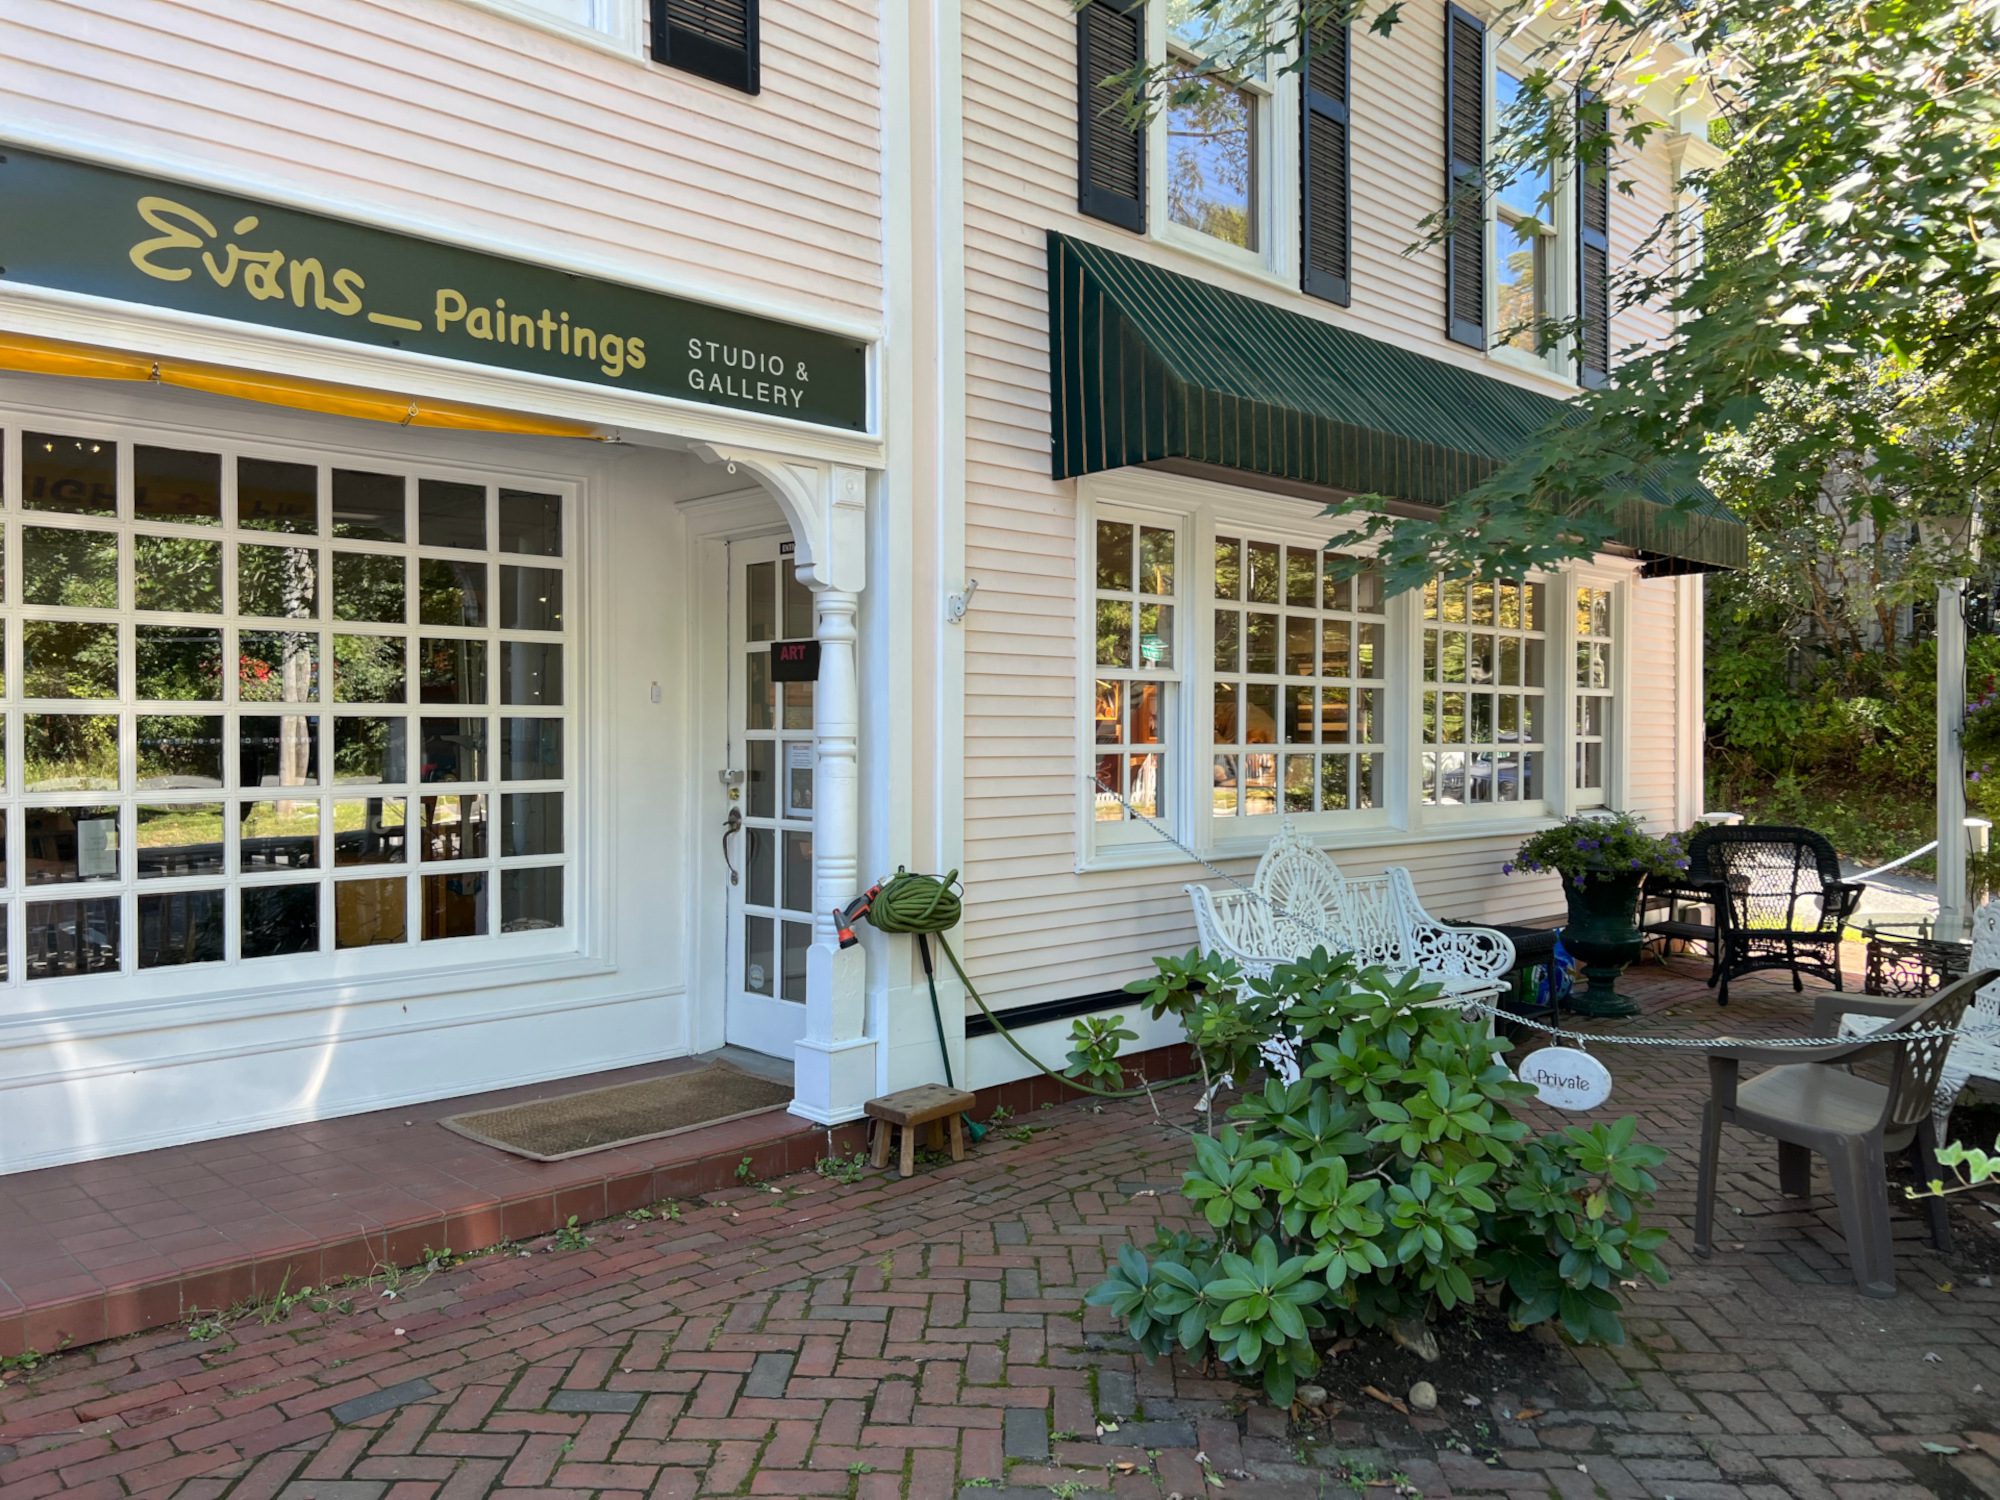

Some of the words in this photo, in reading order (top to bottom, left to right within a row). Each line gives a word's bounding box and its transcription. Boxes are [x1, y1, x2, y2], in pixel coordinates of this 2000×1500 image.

[434, 288, 647, 378] Paintings
[687, 337, 785, 376] STUDIO
[795, 361, 810, 382] &
[687, 368, 805, 408] GALLERY
[780, 644, 806, 662] ART
[1536, 1068, 1590, 1092] Private
